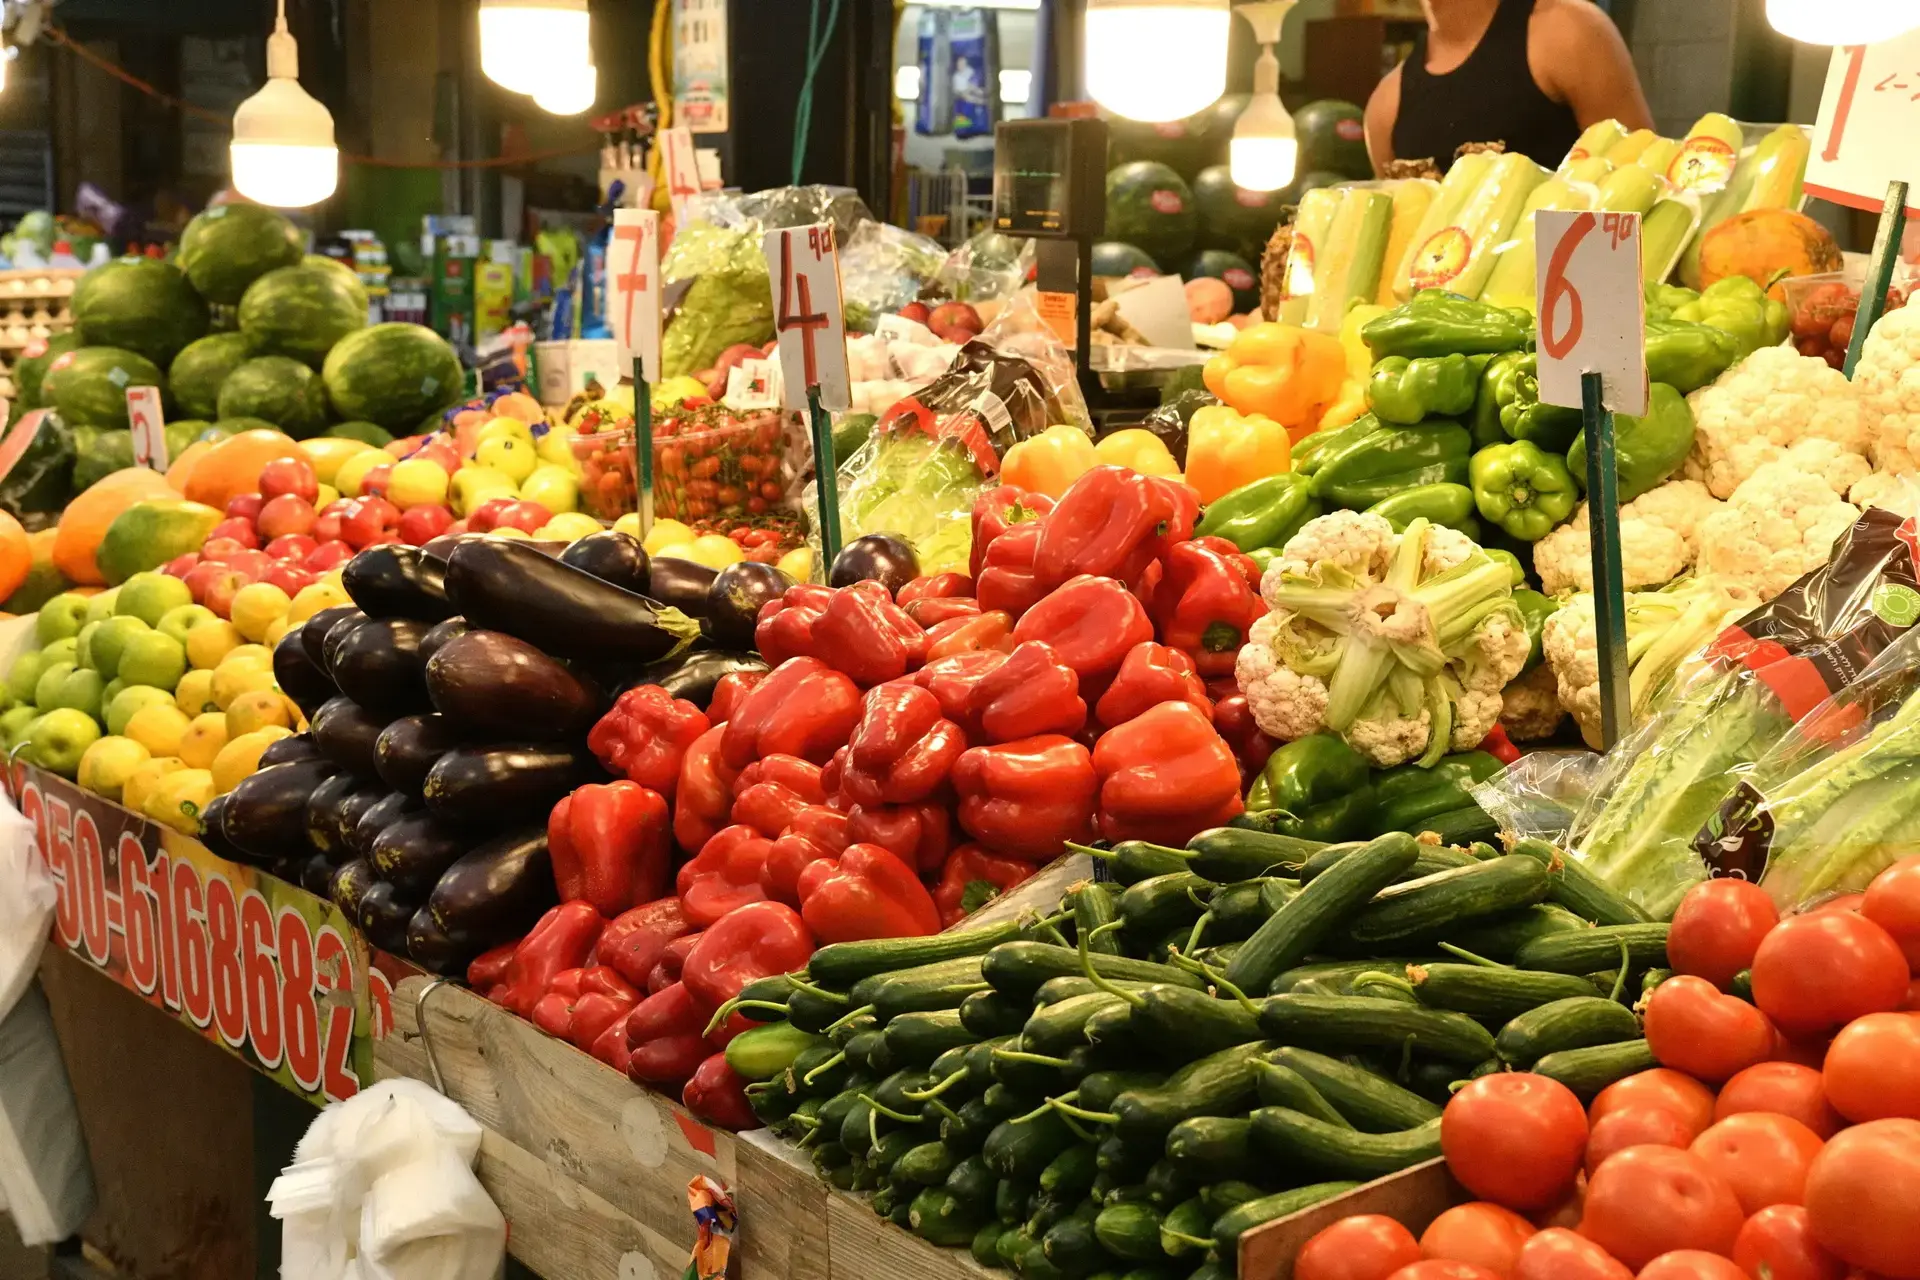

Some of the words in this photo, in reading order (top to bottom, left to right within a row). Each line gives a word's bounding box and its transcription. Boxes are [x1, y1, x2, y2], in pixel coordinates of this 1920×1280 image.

[614, 225, 647, 349] 7
[777, 230, 830, 386] 4
[808, 226, 833, 261] 90
[1541, 212, 1597, 360] 6
[1602, 213, 1635, 251] 90
